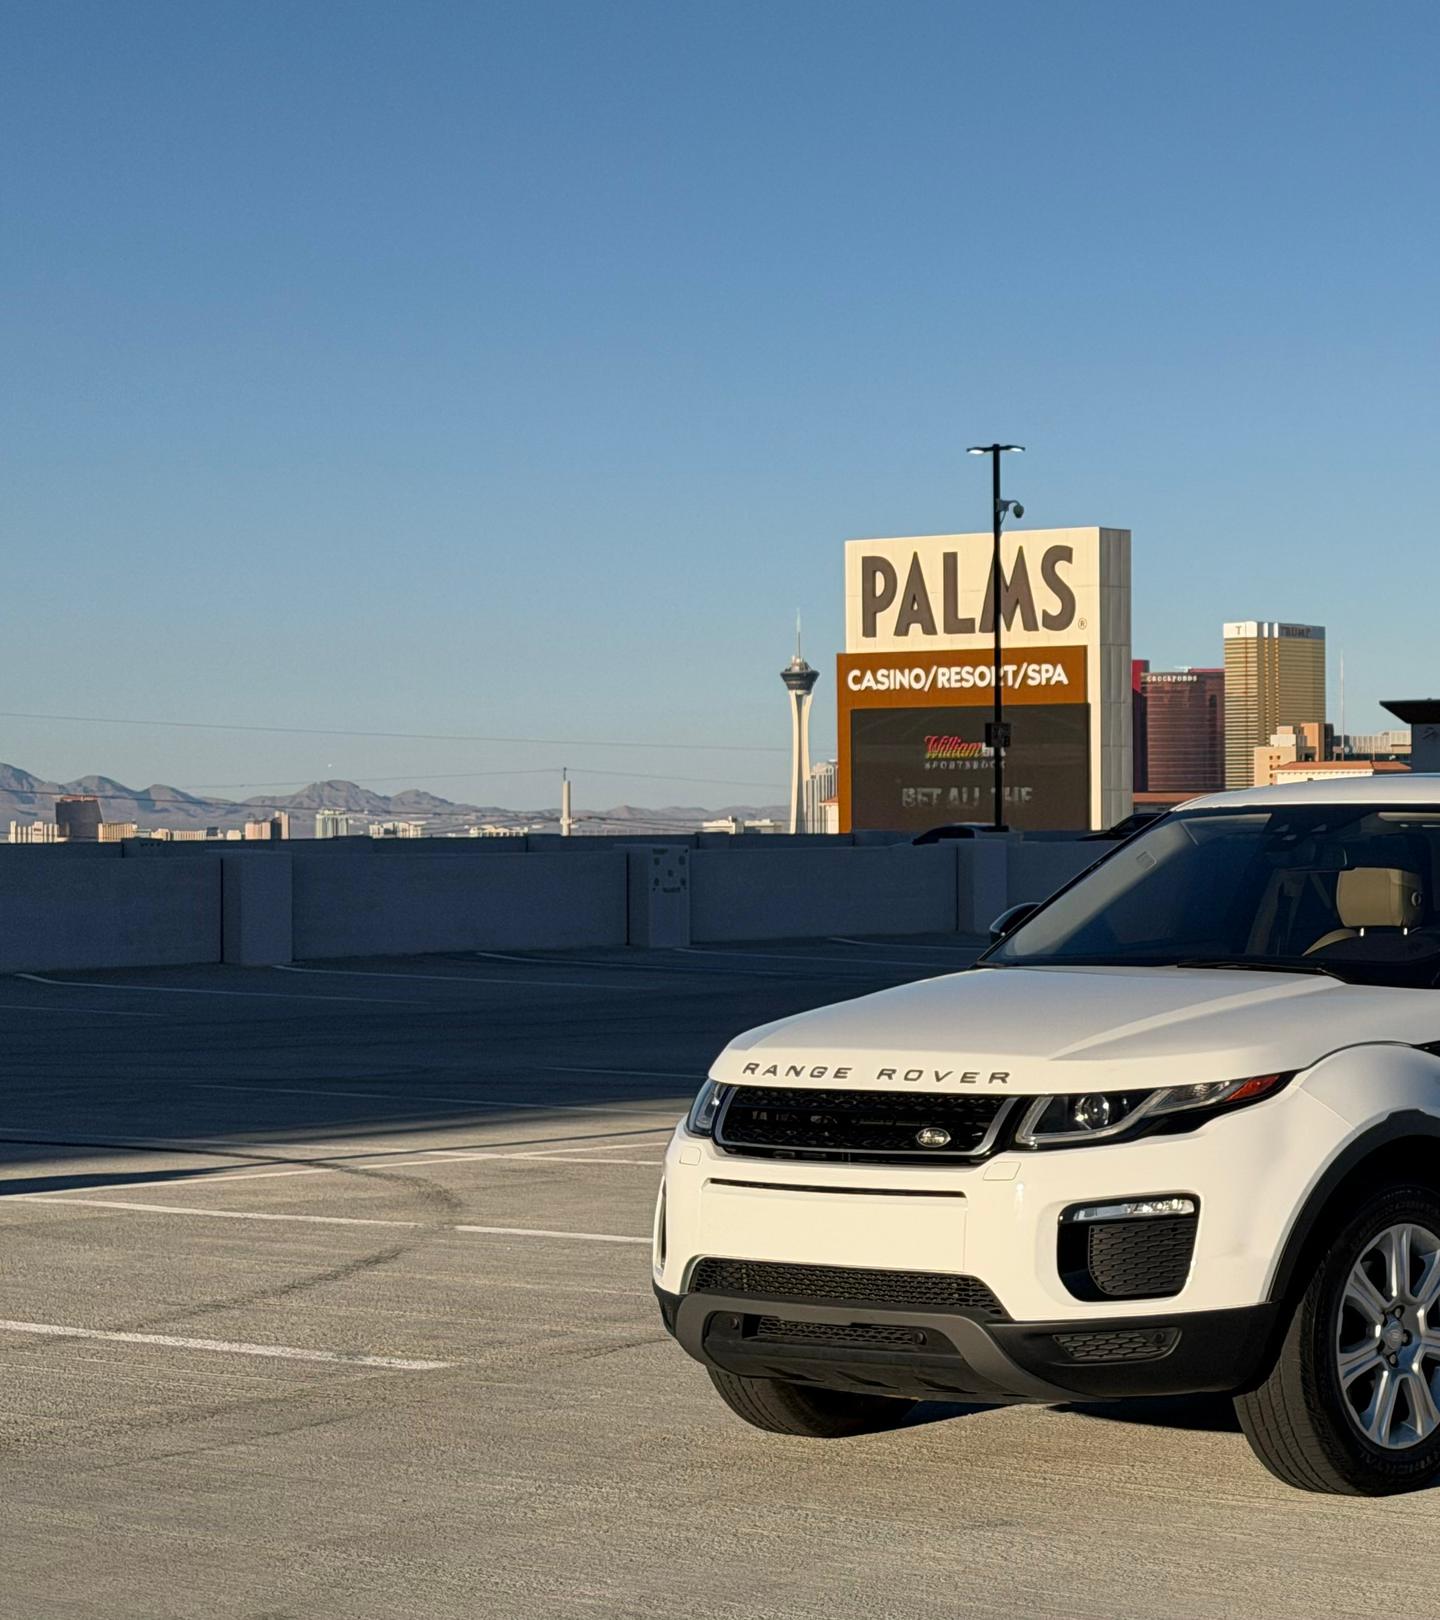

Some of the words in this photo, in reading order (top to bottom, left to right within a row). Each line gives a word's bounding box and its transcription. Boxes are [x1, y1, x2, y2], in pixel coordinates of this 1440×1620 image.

[861, 544, 1076, 638] PALMS
[924, 735, 983, 759] William
[742, 1062, 853, 1080] RANGE
[876, 1067, 1011, 1085] ROVER
